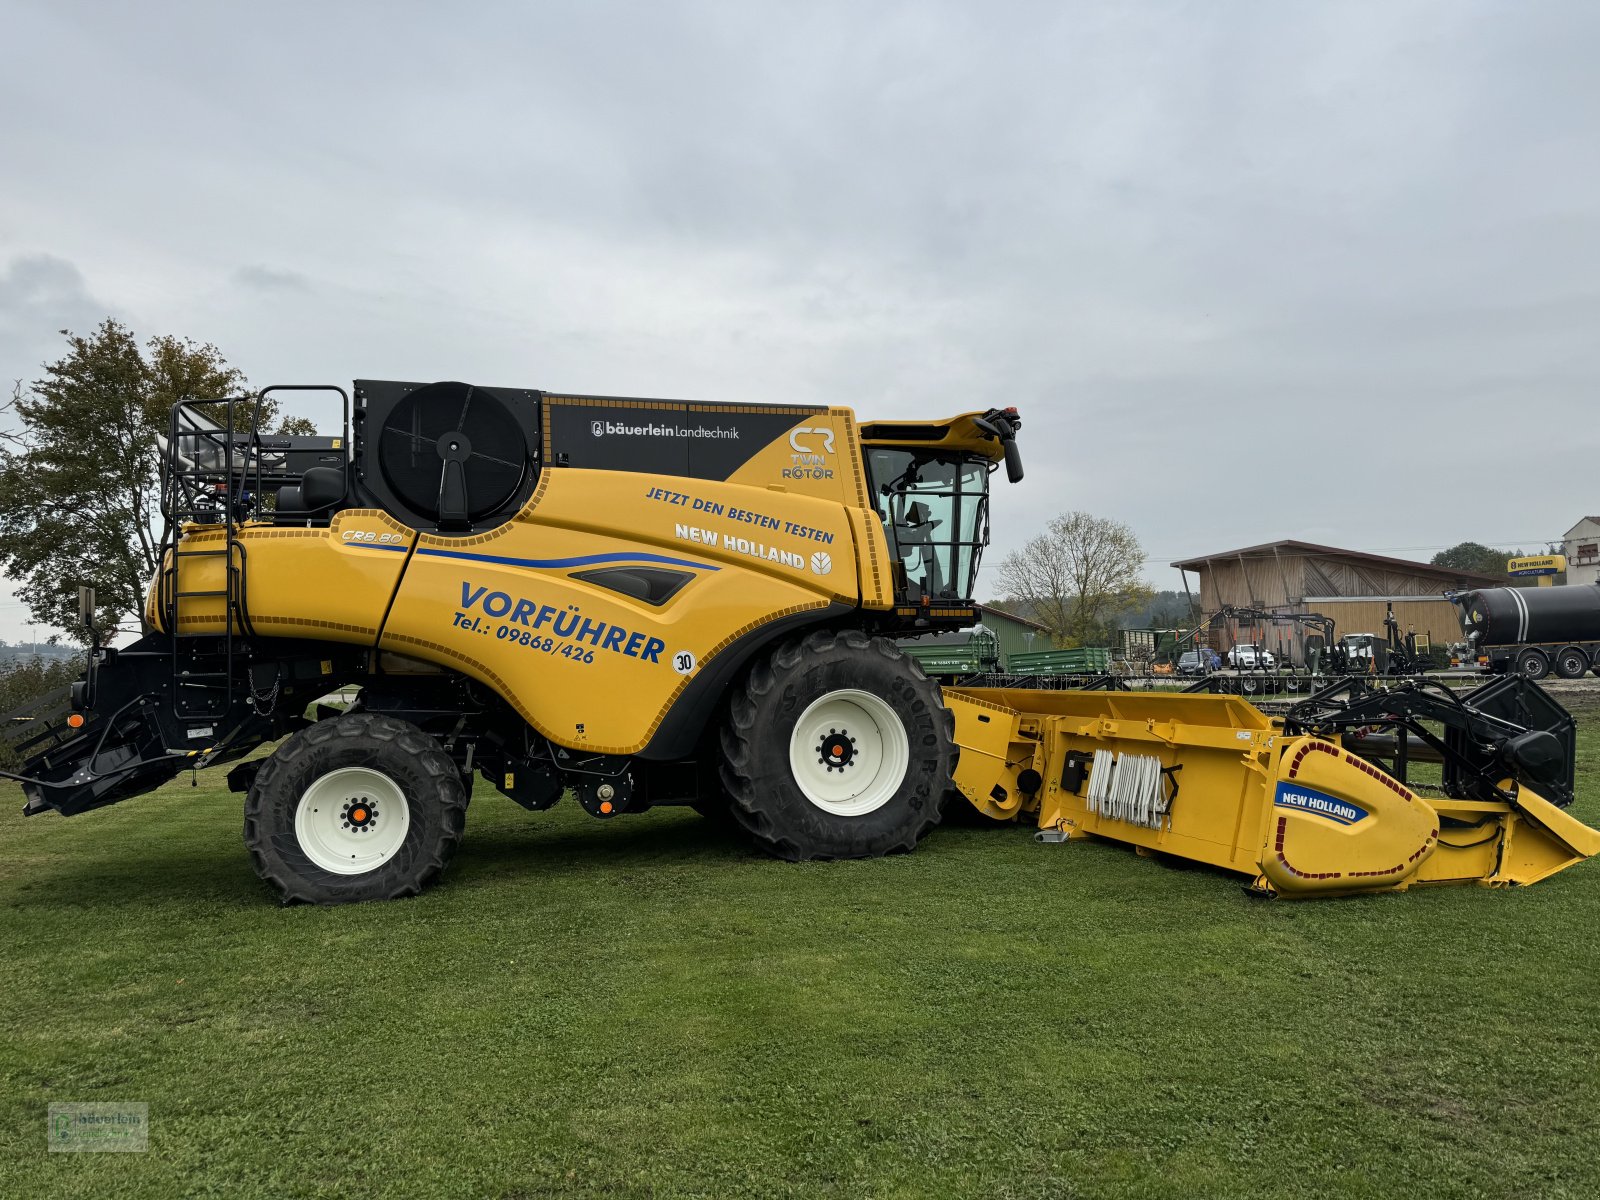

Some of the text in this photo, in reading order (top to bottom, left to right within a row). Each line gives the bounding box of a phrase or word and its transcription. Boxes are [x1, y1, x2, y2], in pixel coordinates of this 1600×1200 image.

[605, 421, 740, 440] bäuerlein Landtechnik
[788, 427, 836, 454] CR
[782, 465, 834, 480] ROTOR
[790, 454, 825, 466] TWIN
[646, 487, 835, 545] JETZT DEN BESTEN TESTEN
[341, 529, 403, 545] CR8.80
[674, 523, 805, 570] NEW HOLLAND
[460, 581, 666, 665] VORFÜHRER
[451, 611, 595, 665] Tel.: 09868/426
[676, 653, 693, 671] 30
[1283, 793, 1356, 819] NEW HOLLAND
